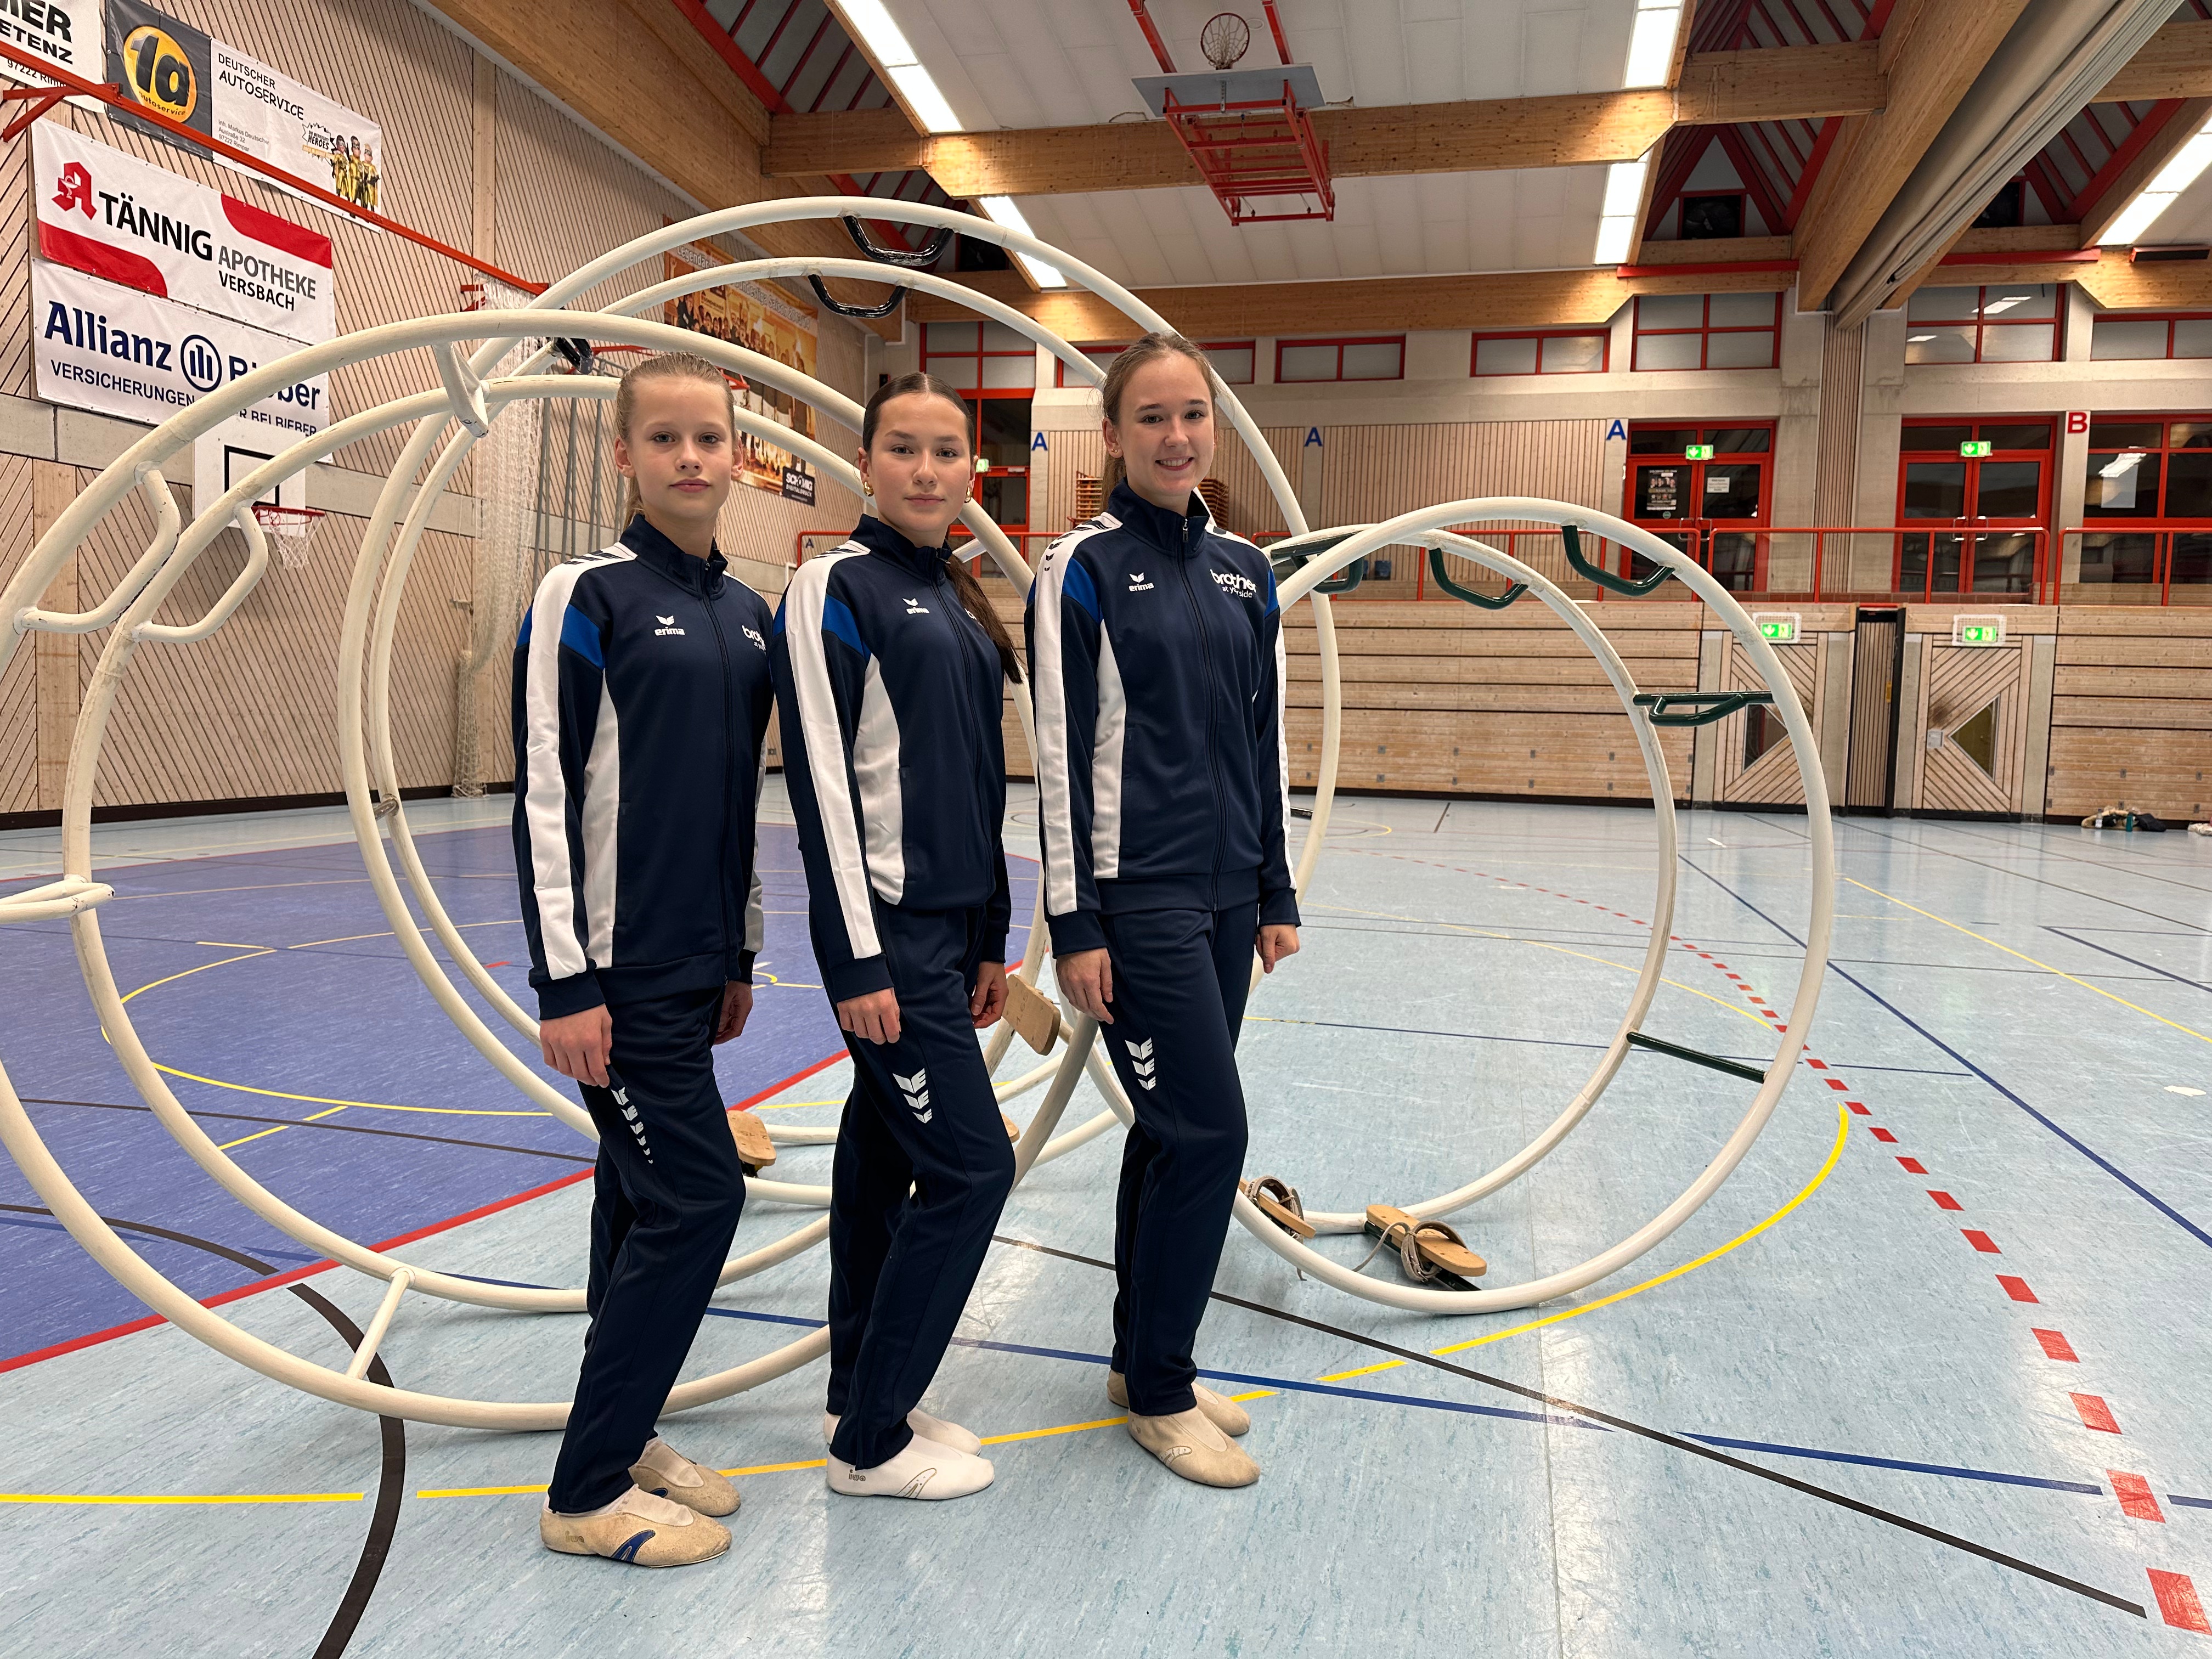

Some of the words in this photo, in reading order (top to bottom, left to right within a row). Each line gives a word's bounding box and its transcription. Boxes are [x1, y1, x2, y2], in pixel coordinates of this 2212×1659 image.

[131, 33, 190, 106] 1a
[218, 53, 275, 89] DEUTSCHER
[138, 91, 185, 115] autoservice
[219, 70, 304, 121] AUTOSERVICE
[218, 119, 227, 127] Inh.
[228, 123, 244, 136] Markus
[245, 131, 269, 145] Deutscher
[308, 135, 329, 150] HEROES
[233, 140, 250, 152] Rimpar
[99, 191, 212, 261] TÄNNIG
[218, 245, 316, 300] APOTHEKE
[218, 270, 295, 312] VERSBACH
[44, 300, 172, 371] Allianz
[50, 359, 195, 407] VERSICHERUNGEN
[1606, 420, 1626, 441] A
[2067, 412, 2087, 434] B
[1031, 432, 1048, 451] A
[1304, 427, 1323, 447] A
[805, 538, 814, 548] A
[1128, 583, 1154, 592] erima
[1210, 569, 1256, 593] brother
[1229, 586, 1239, 595] yor
[654, 627, 685, 636] erima
[848, 1469, 866, 1482] iwa
